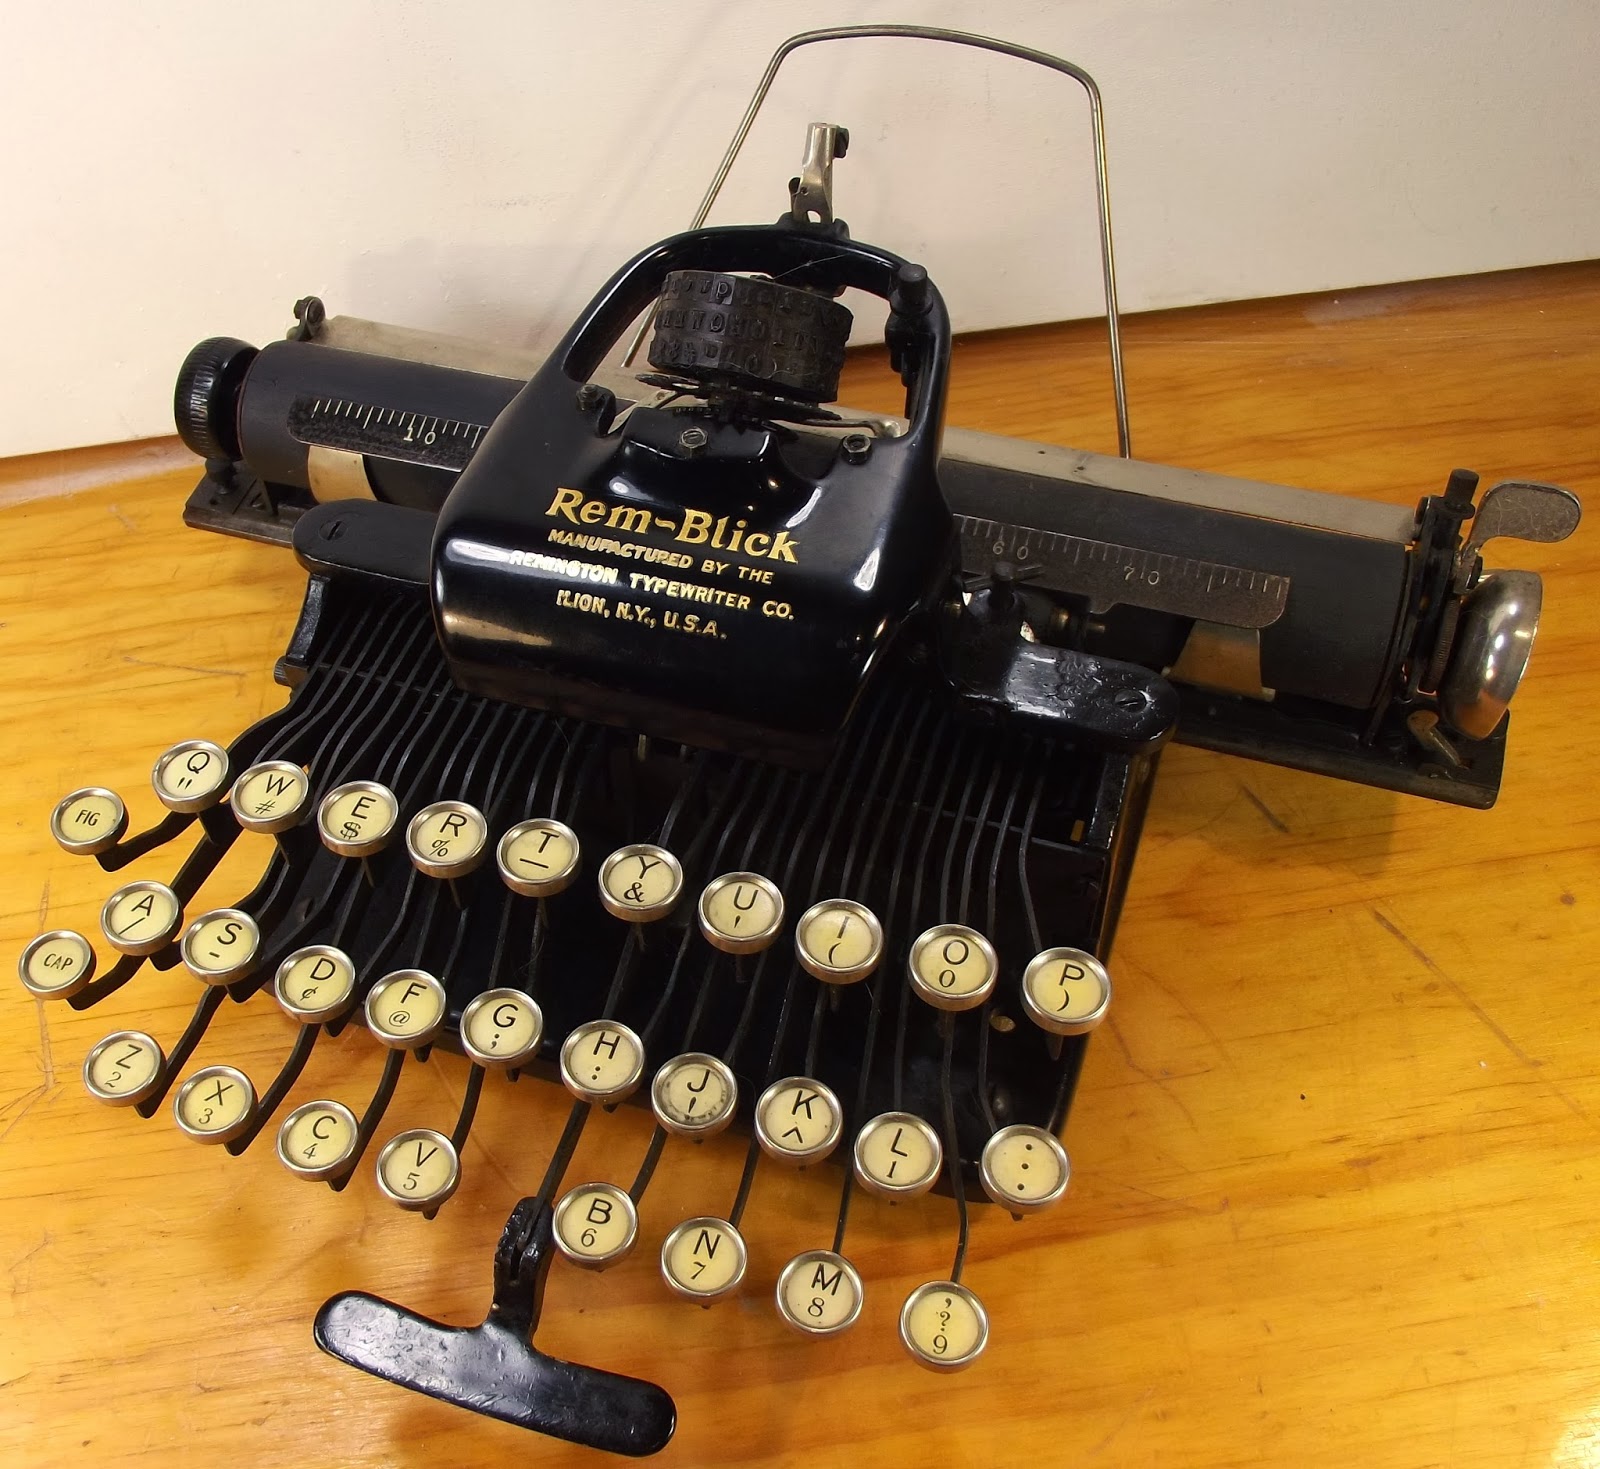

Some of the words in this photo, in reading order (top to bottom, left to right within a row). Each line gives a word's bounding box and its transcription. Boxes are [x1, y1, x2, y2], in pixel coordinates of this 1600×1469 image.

[403, 426, 437, 446] 10
[545, 487, 801, 564] Rem-Blick
[548, 528, 694, 569] MANUFACTURED
[700, 558, 732, 576] BY
[738, 565, 775, 585] THE
[992, 540, 1030, 561] 60
[1122, 565, 1161, 586] 70
[509, 549, 619, 585] REMINGTON
[629, 572, 751, 611] TYPEWRITER
[762, 599, 795, 621] CO.
[556, 589, 611, 619] ILION,
[663, 610, 729, 639] U.S.A.
[187, 752, 211, 775] Q
[265, 774, 296, 797] W
[75, 810, 101, 826] FIG
[255, 800, 276, 815] #
[350, 796, 377, 820] E
[340, 821, 362, 841] $
[439, 813, 467, 837] R
[428, 839, 451, 857] %
[537, 831, 560, 854] T
[638, 856, 661, 880] Y
[624, 882, 645, 903] &
[733, 886, 759, 911] U
[131, 894, 155, 917] A
[216, 922, 243, 946] S
[44, 954, 74, 971] CAP
[942, 940, 970, 966] O
[309, 958, 336, 981] D
[1058, 964, 1085, 987] P
[400, 982, 428, 1004] F
[388, 1010, 411, 1028] @
[492, 1003, 519, 1029] G
[115, 1043, 143, 1070] Z
[593, 1031, 622, 1060] H
[105, 1072, 122, 1088] 2
[686, 1069, 712, 1093] J
[204, 1079, 234, 1107] X
[792, 1090, 819, 1119] K
[198, 1108, 213, 1125] 3
[312, 1115, 338, 1140] C
[302, 1143, 318, 1160] 4
[890, 1127, 908, 1157] L
[415, 1141, 439, 1167] V
[403, 1172, 421, 1191] 5
[586, 1197, 613, 1224] B
[580, 1227, 598, 1248] 6
[694, 1229, 721, 1259] N
[690, 1261, 707, 1280] 7
[812, 1263, 843, 1296] M
[807, 1297, 825, 1318] 8
[931, 1334, 949, 1356] 9
